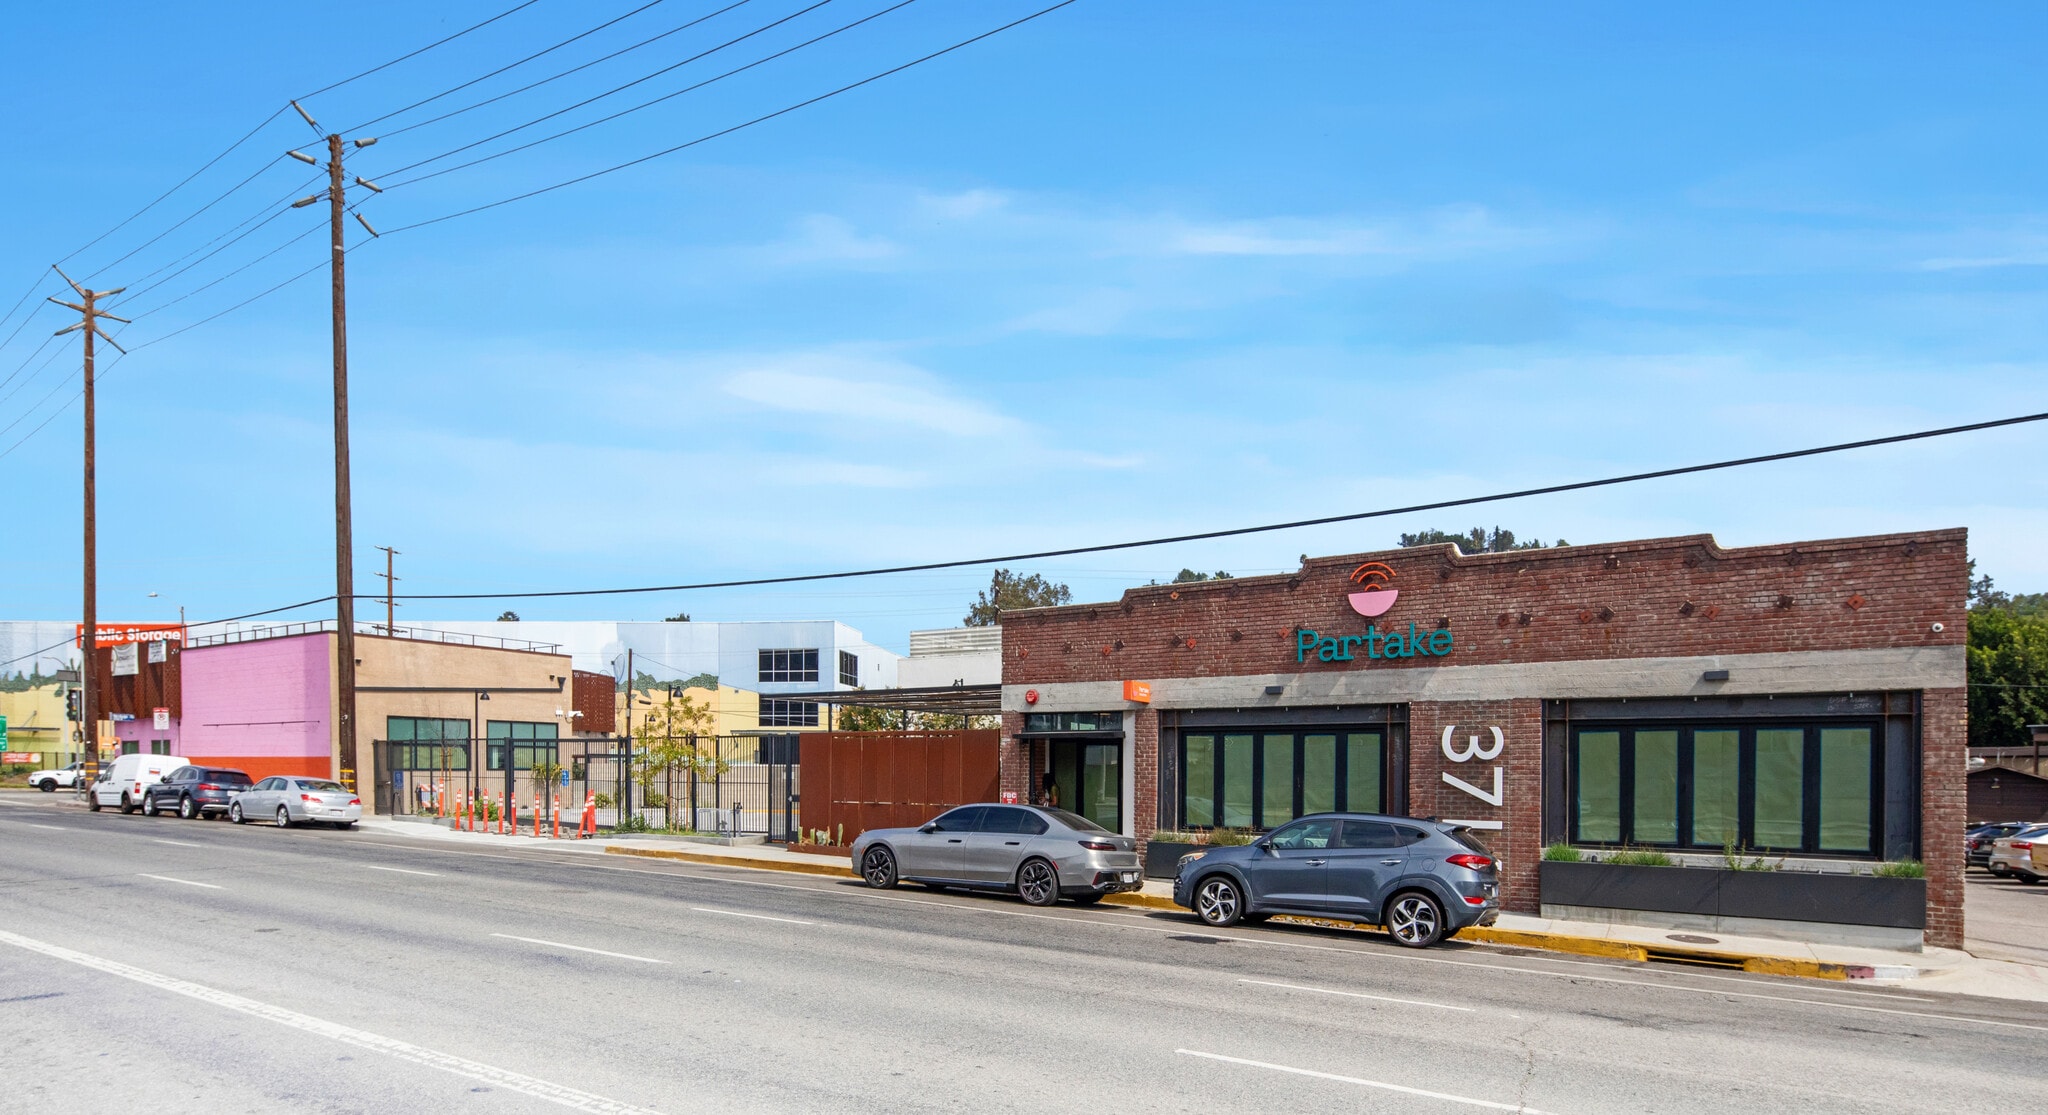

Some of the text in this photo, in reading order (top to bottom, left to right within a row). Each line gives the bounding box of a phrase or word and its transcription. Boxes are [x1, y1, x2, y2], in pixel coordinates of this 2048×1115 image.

[126, 628, 181, 641] Storage
[1297, 622, 1453, 663] Partake
[1441, 725, 1505, 872] 371
